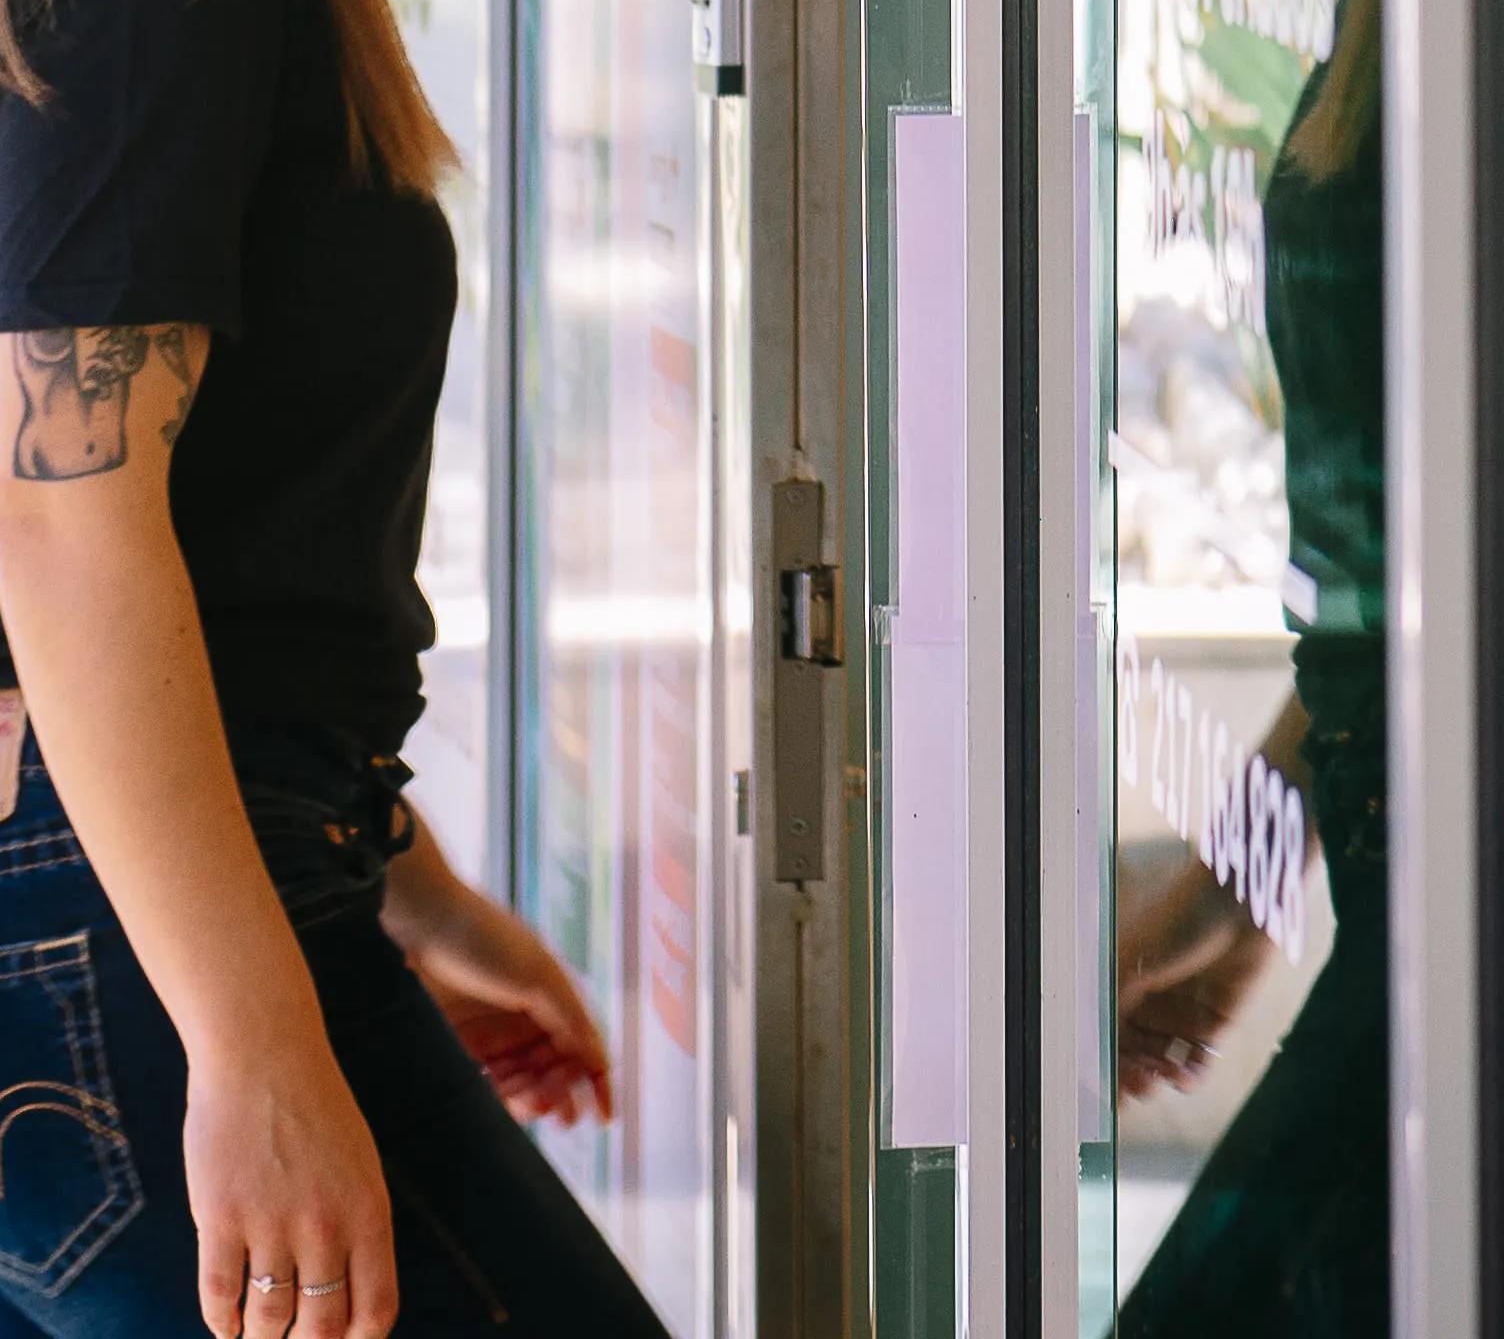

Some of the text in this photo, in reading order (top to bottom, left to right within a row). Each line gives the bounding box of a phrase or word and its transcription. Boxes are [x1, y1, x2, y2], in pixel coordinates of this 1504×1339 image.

[1150, 656, 1306, 969] 217 164 828
